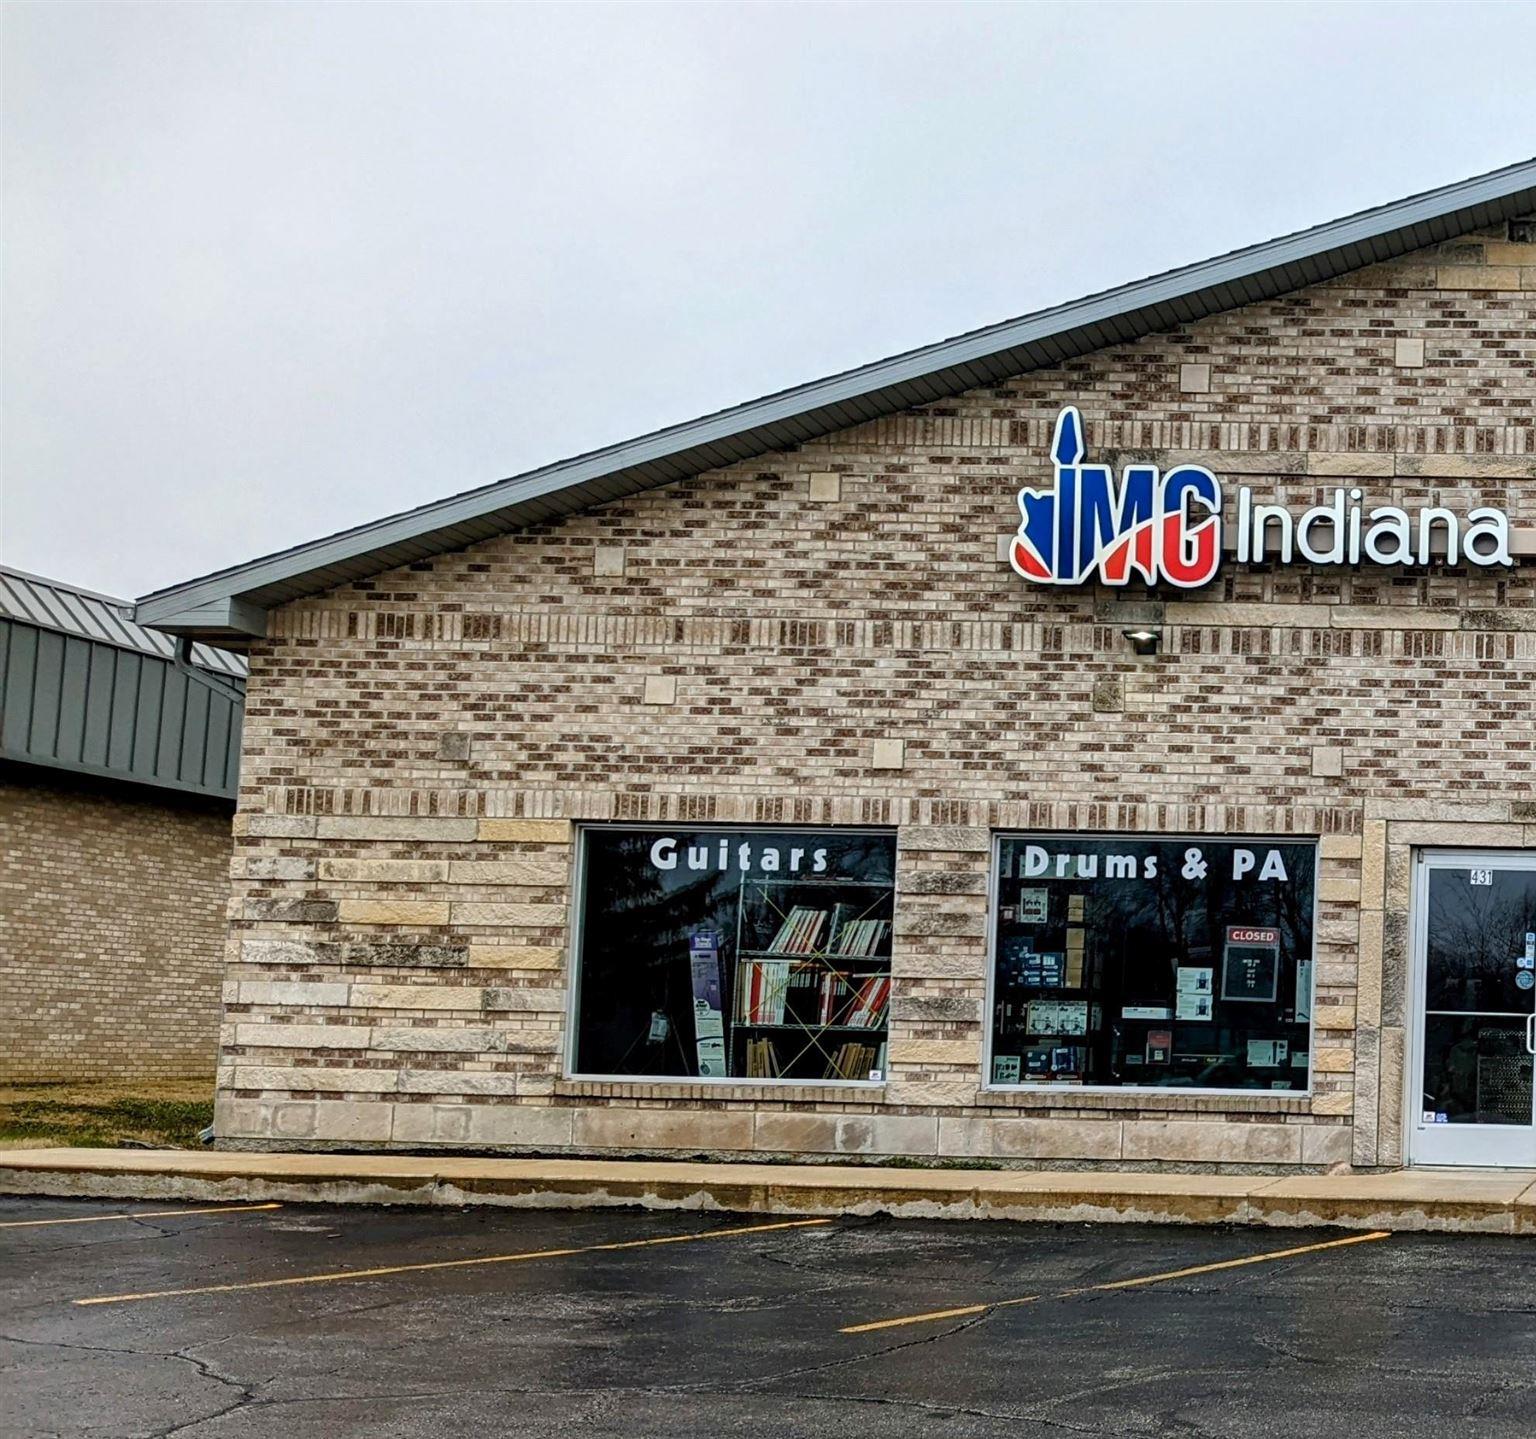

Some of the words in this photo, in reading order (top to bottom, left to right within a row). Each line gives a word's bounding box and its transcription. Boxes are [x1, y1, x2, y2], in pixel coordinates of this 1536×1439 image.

[1048, 405, 1223, 588] IMG
[1236, 486, 1513, 567] Indiana
[650, 837, 828, 872] Guitars
[1024, 844, 1158, 880] Drums
[1181, 847, 1208, 880] &
[1232, 848, 1289, 882] PA
[1471, 870, 1491, 884] 431
[1232, 931, 1274, 942] CLOSED
